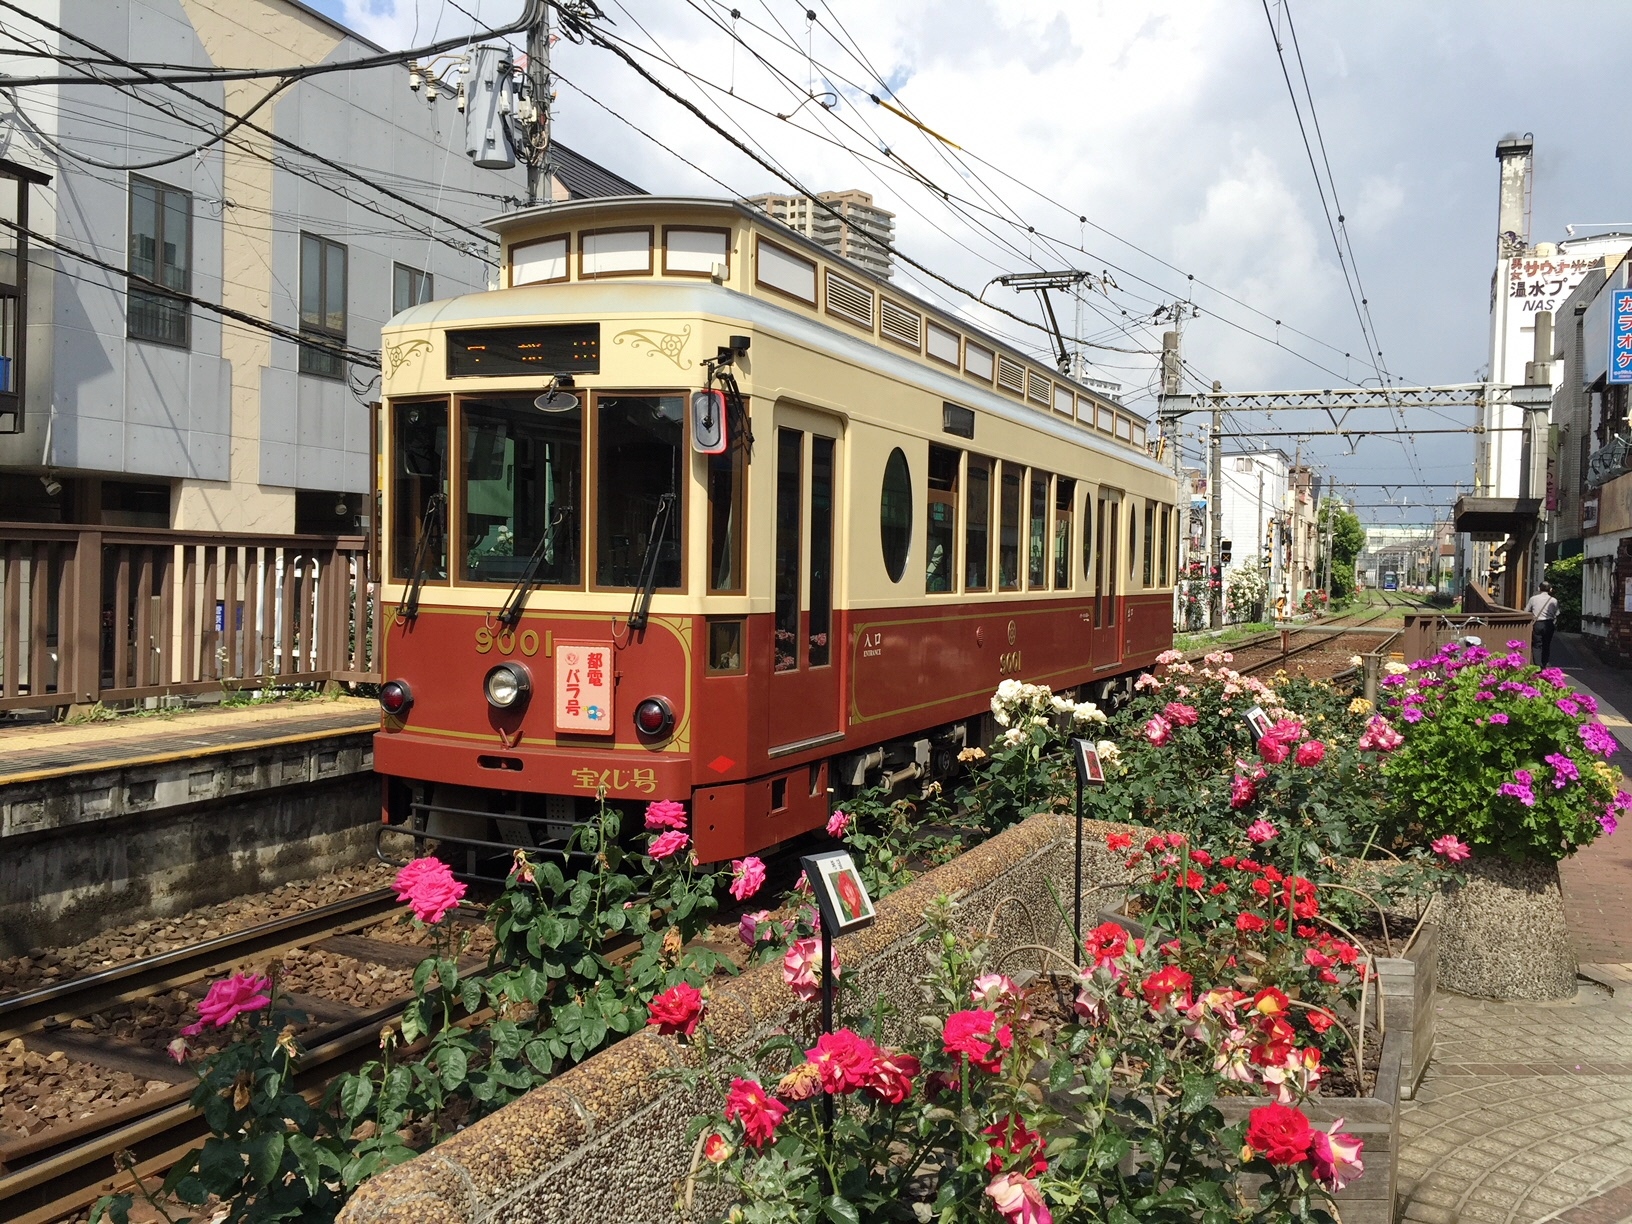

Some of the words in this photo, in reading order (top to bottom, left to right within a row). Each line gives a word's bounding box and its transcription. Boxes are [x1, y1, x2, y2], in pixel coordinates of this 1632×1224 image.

[1523, 299, 1555, 311] NAS
[1616, 296, 1632, 368] カラオケ
[475, 627, 552, 659] 9001
[863, 633, 881, 648] 入口
[587, 652, 603, 687] 都電
[999, 650, 1022, 676] 9001
[565, 668, 581, 717] バラ号
[571, 768, 658, 793] 宝くじ号
